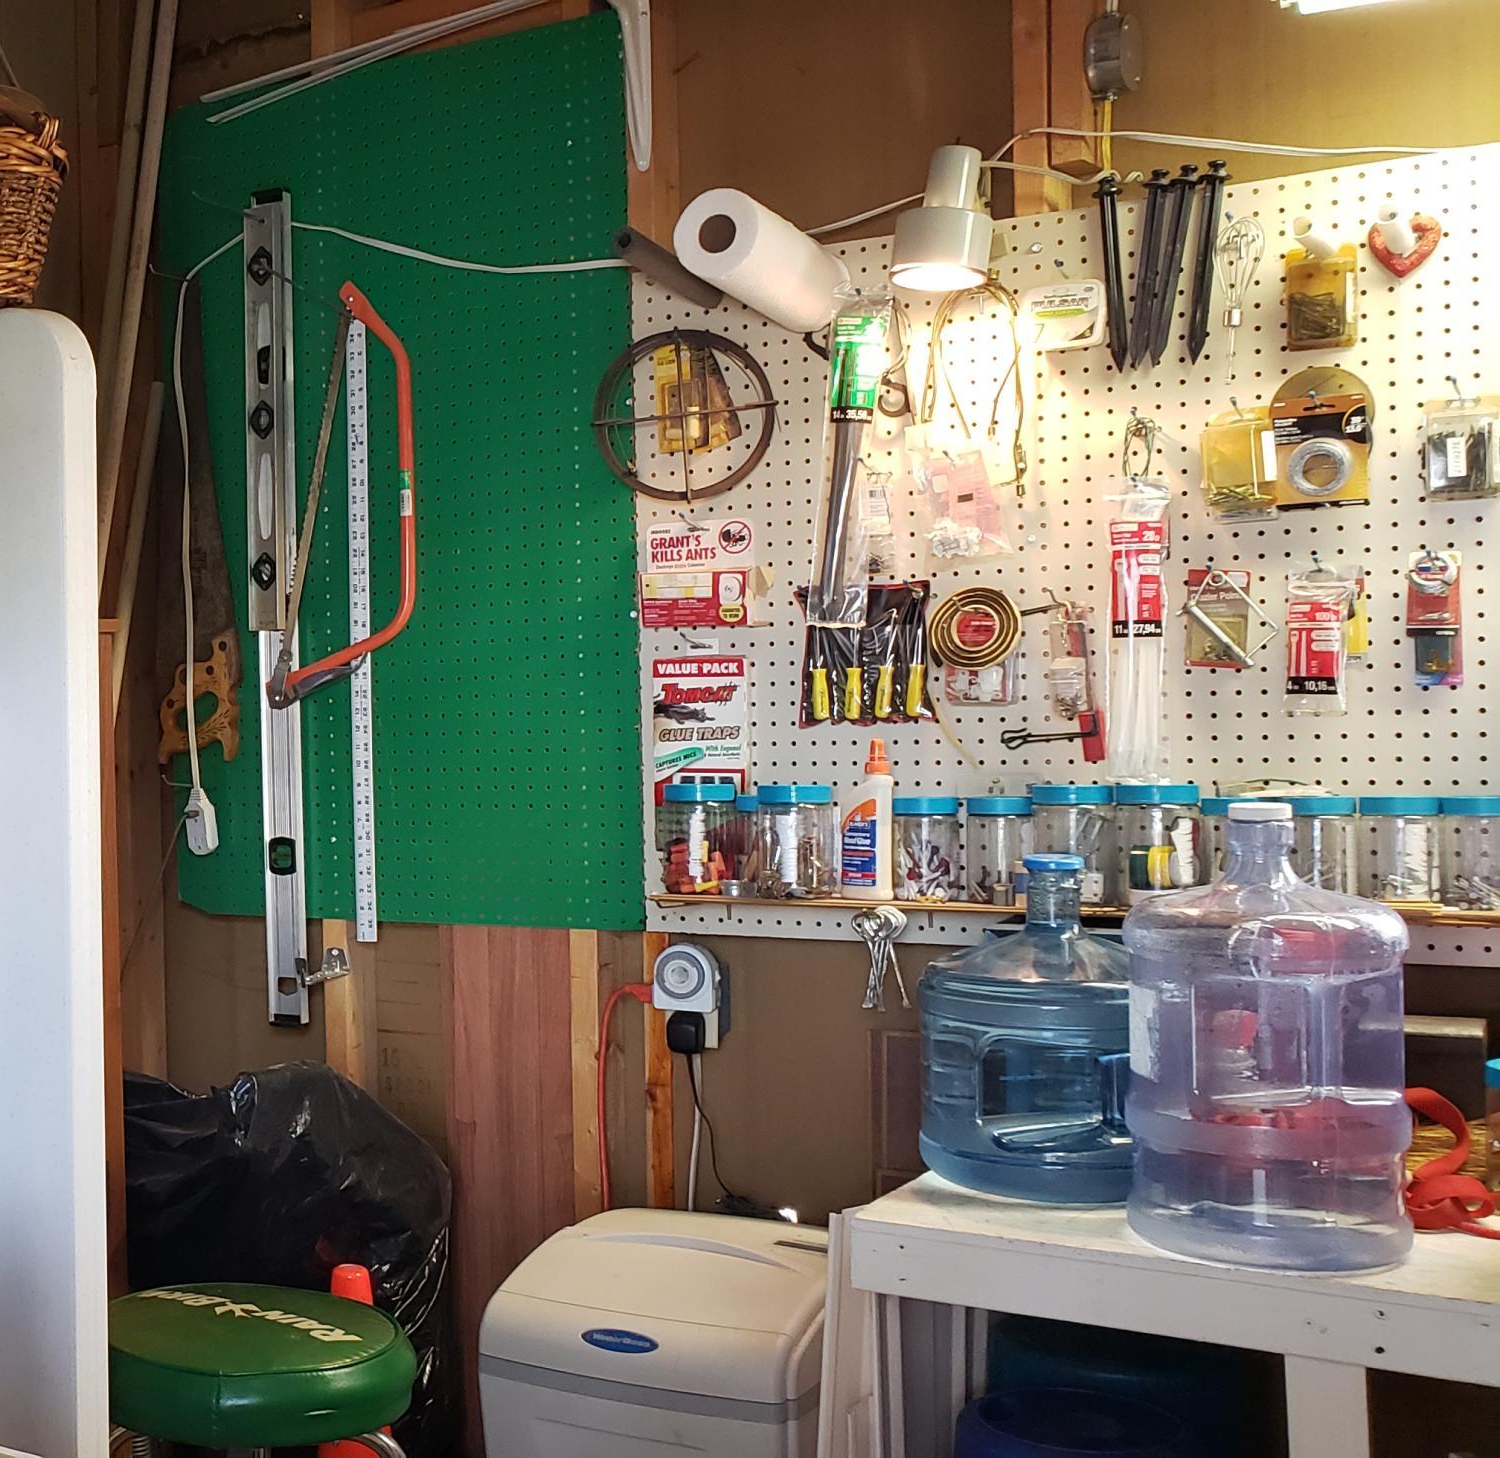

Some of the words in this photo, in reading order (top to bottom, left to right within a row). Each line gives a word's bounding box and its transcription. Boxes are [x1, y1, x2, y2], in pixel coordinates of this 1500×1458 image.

[650, 534, 702, 550] GRANT'S
[651, 549, 683, 563] KILLS
[685, 547, 717, 561] ANTS
[656, 662, 699, 675] VALUE
[701, 661, 740, 675] PACK
[658, 727, 695, 742] GLUE
[696, 725, 741, 741] TRAPS
